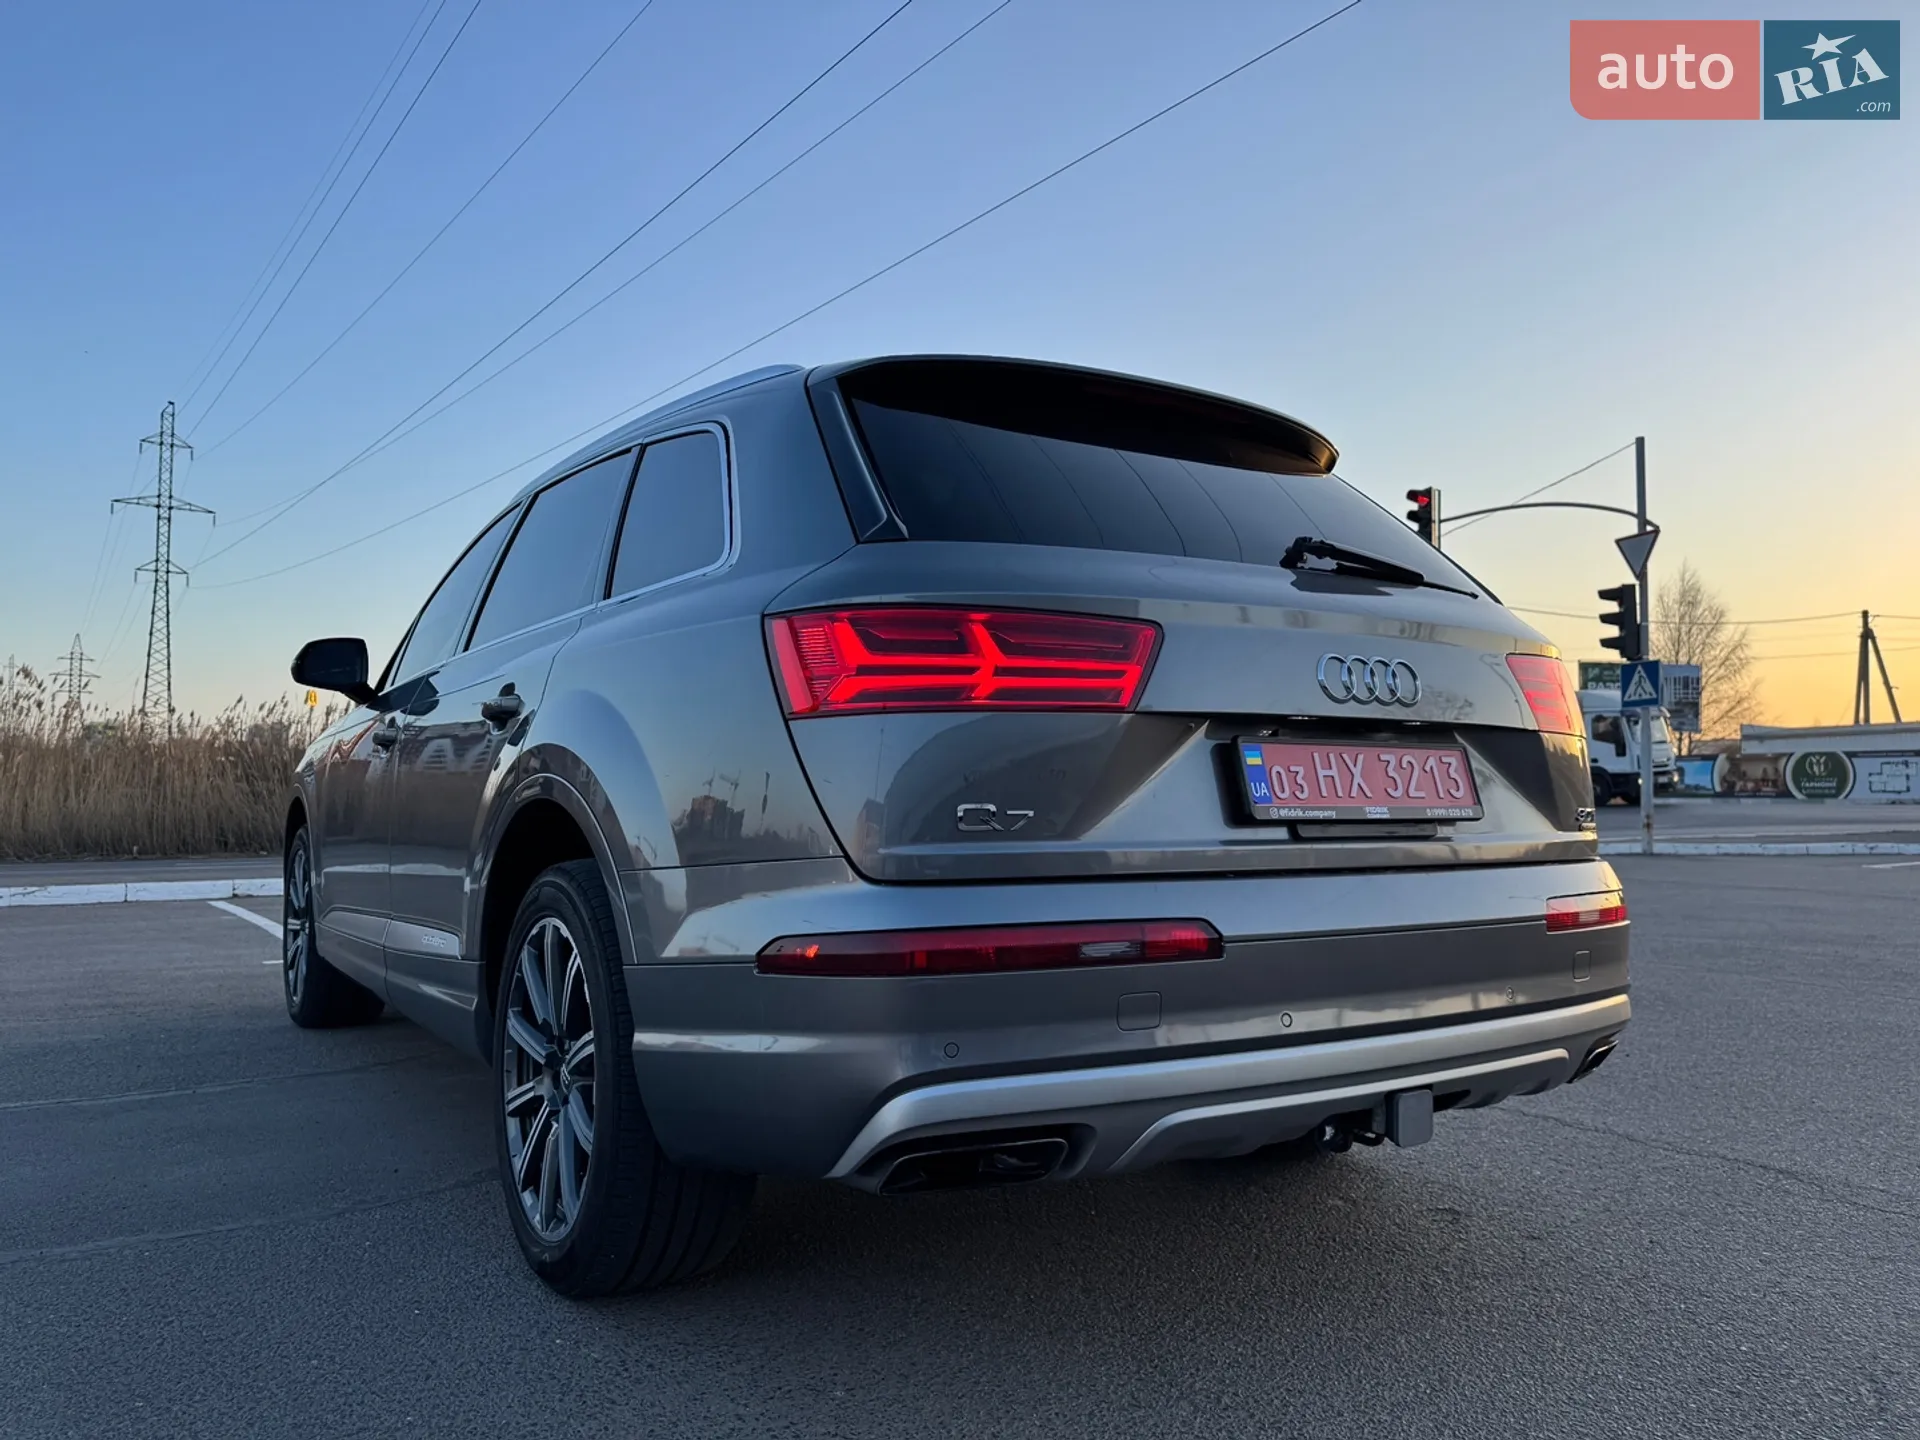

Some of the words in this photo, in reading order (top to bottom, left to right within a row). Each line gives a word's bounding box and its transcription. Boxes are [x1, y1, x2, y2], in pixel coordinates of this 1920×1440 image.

[1251, 781, 1269, 797] UA
[1270, 764, 1309, 800] 03
[1311, 751, 1373, 798] HX
[1378, 753, 1465, 799] 3213
[957, 803, 1034, 832] Q7
